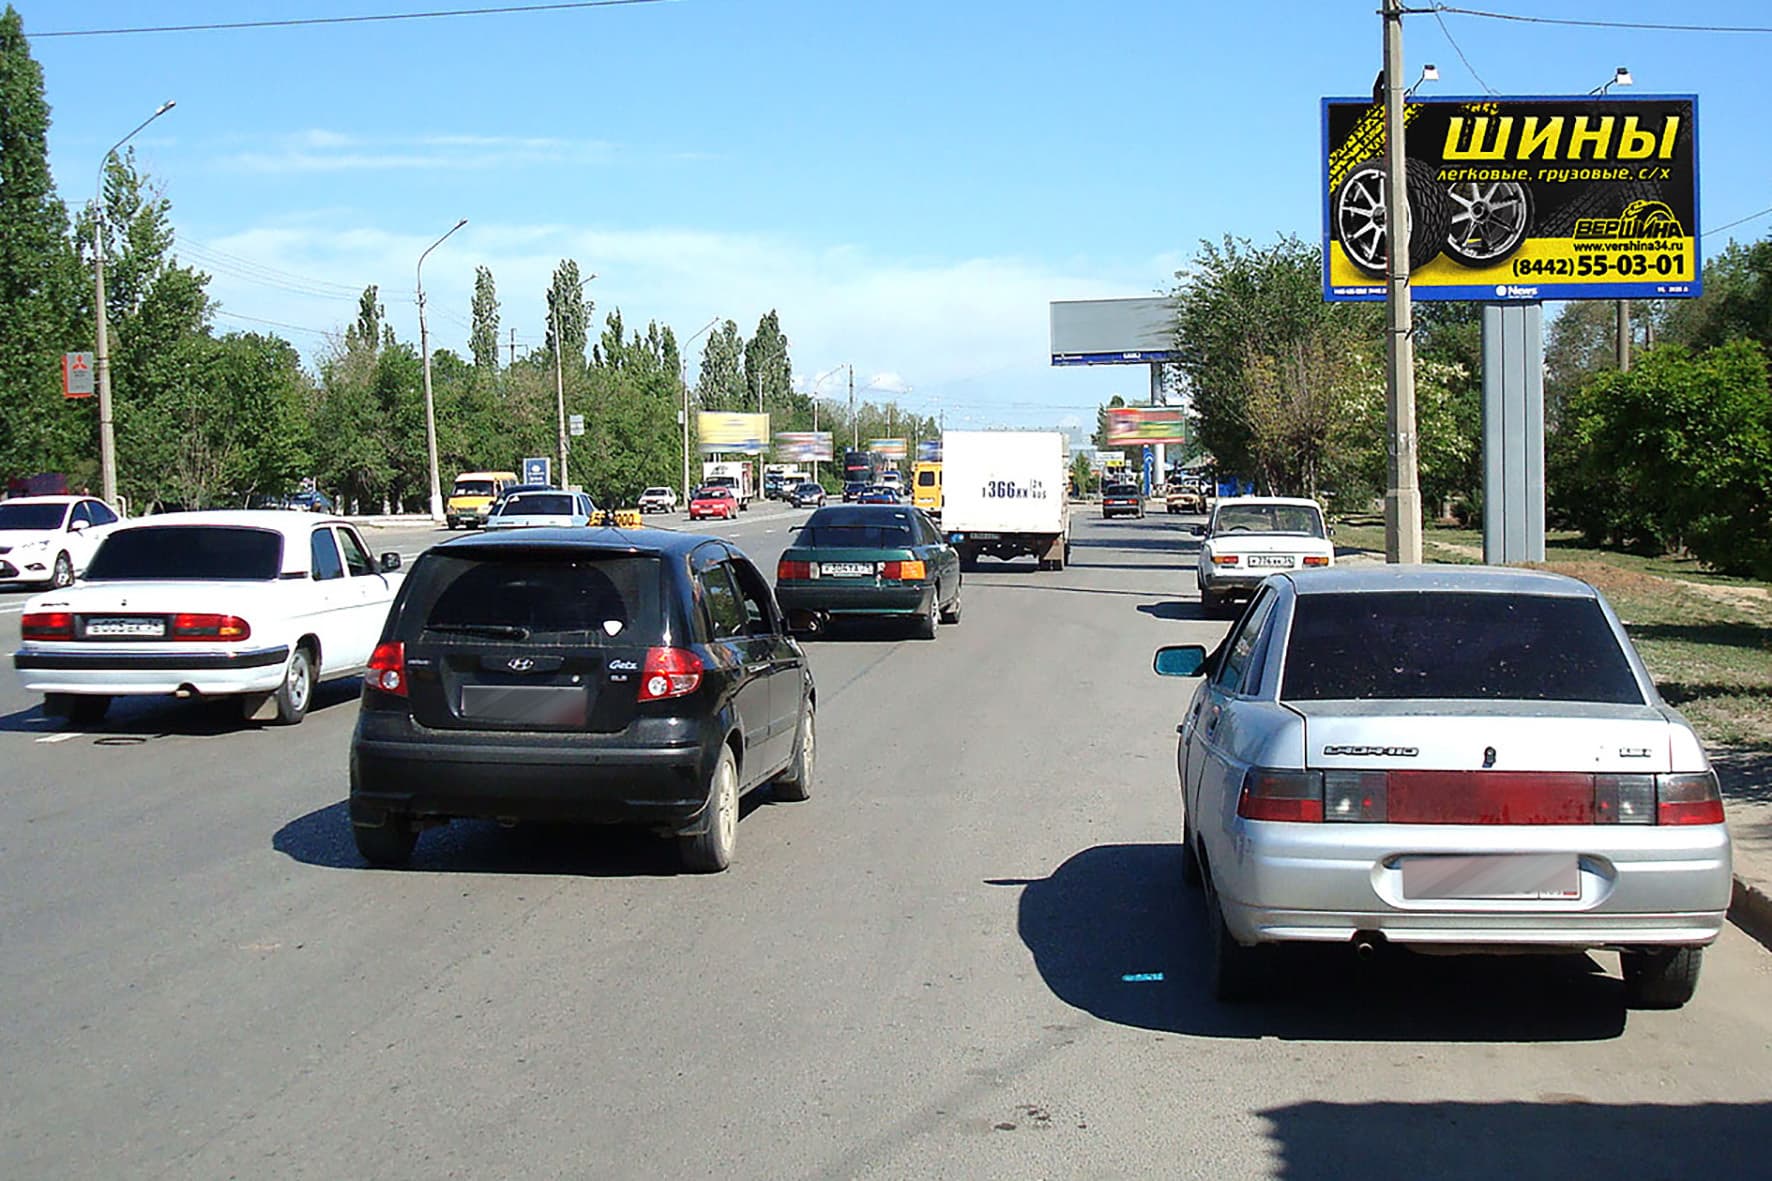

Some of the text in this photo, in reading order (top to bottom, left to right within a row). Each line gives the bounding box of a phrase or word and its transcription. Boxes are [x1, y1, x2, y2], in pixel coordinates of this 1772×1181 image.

[1442, 116, 1680, 160] ШИНЫ
[1437, 166, 1670, 182] легковые, грузовые, с/х
[1574, 218, 1684, 239] ВЕРШИНА
[1574, 240, 1683, 252] www.vershina34.ru
[1513, 255, 1684, 276] (8442) 55-03-01
[609, 659, 638, 670] Getz
